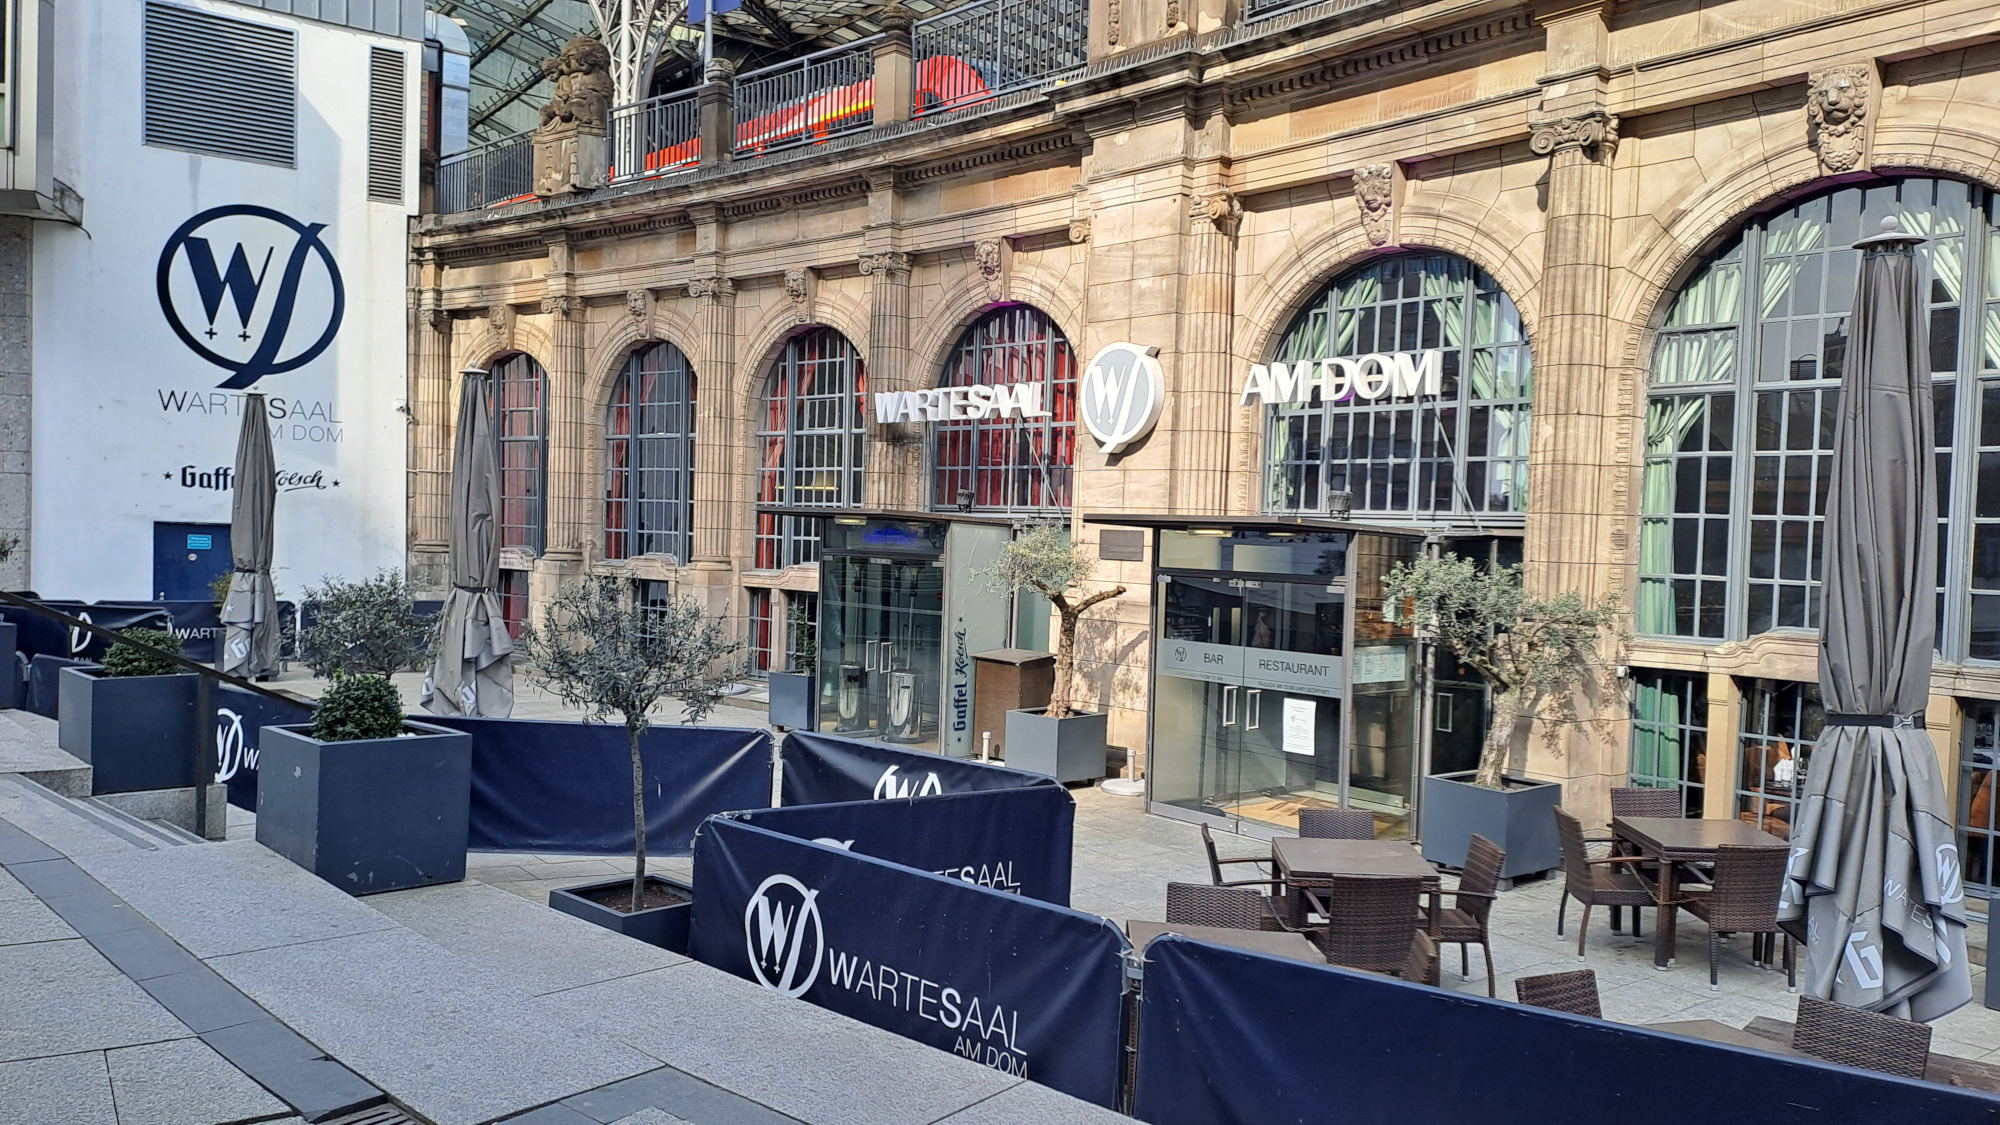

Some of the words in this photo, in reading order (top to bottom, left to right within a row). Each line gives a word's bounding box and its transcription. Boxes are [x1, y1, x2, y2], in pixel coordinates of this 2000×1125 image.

[1239, 359, 1314, 406] AM
[1320, 349, 1443, 402] DOM
[158, 389, 343, 423] WARTSAAL
[875, 382, 1052, 423] WARTESAAL
[292, 424, 343, 443] DOM
[181, 465, 235, 491] Gaff
[274, 469, 327, 493] ölsch
[955, 628, 969, 678] Kölsch
[1203, 652, 1224, 665] BAR
[1258, 658, 1330, 677] RESTAURANT
[953, 681, 968, 732] Gaffel
[829, 948, 1027, 1056] WARTESAAL
[954, 1036, 981, 1061] AM
[986, 1046, 1028, 1081] DOM
